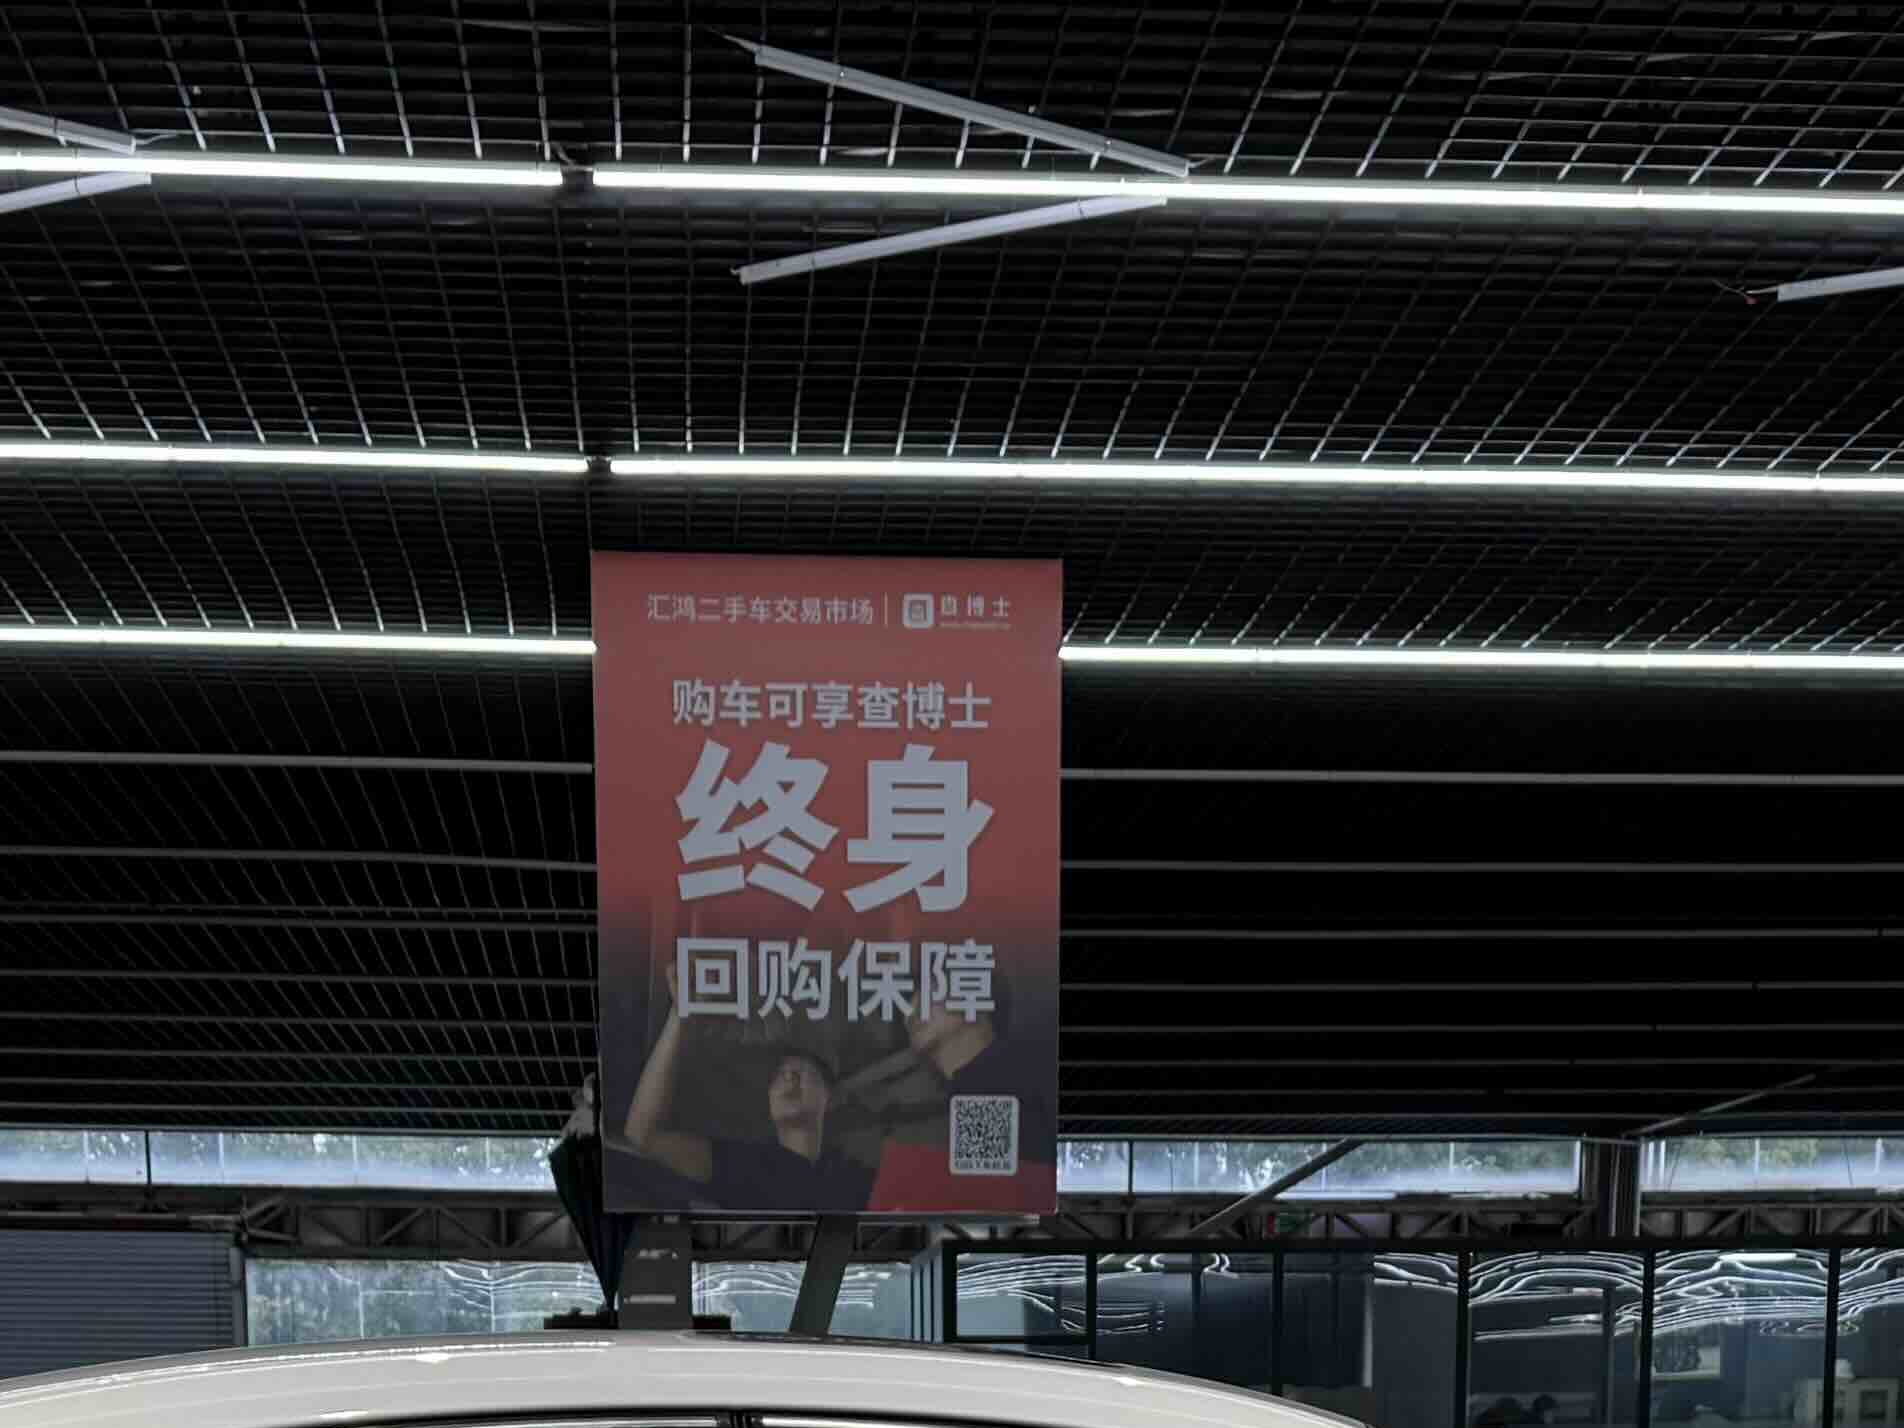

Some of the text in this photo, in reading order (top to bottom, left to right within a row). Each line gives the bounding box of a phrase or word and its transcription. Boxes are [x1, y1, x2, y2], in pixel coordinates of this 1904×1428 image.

[672, 679, 992, 729] 购车可享查博士
[675, 738, 994, 913] 终身
[677, 936, 996, 1022] 回购保障
